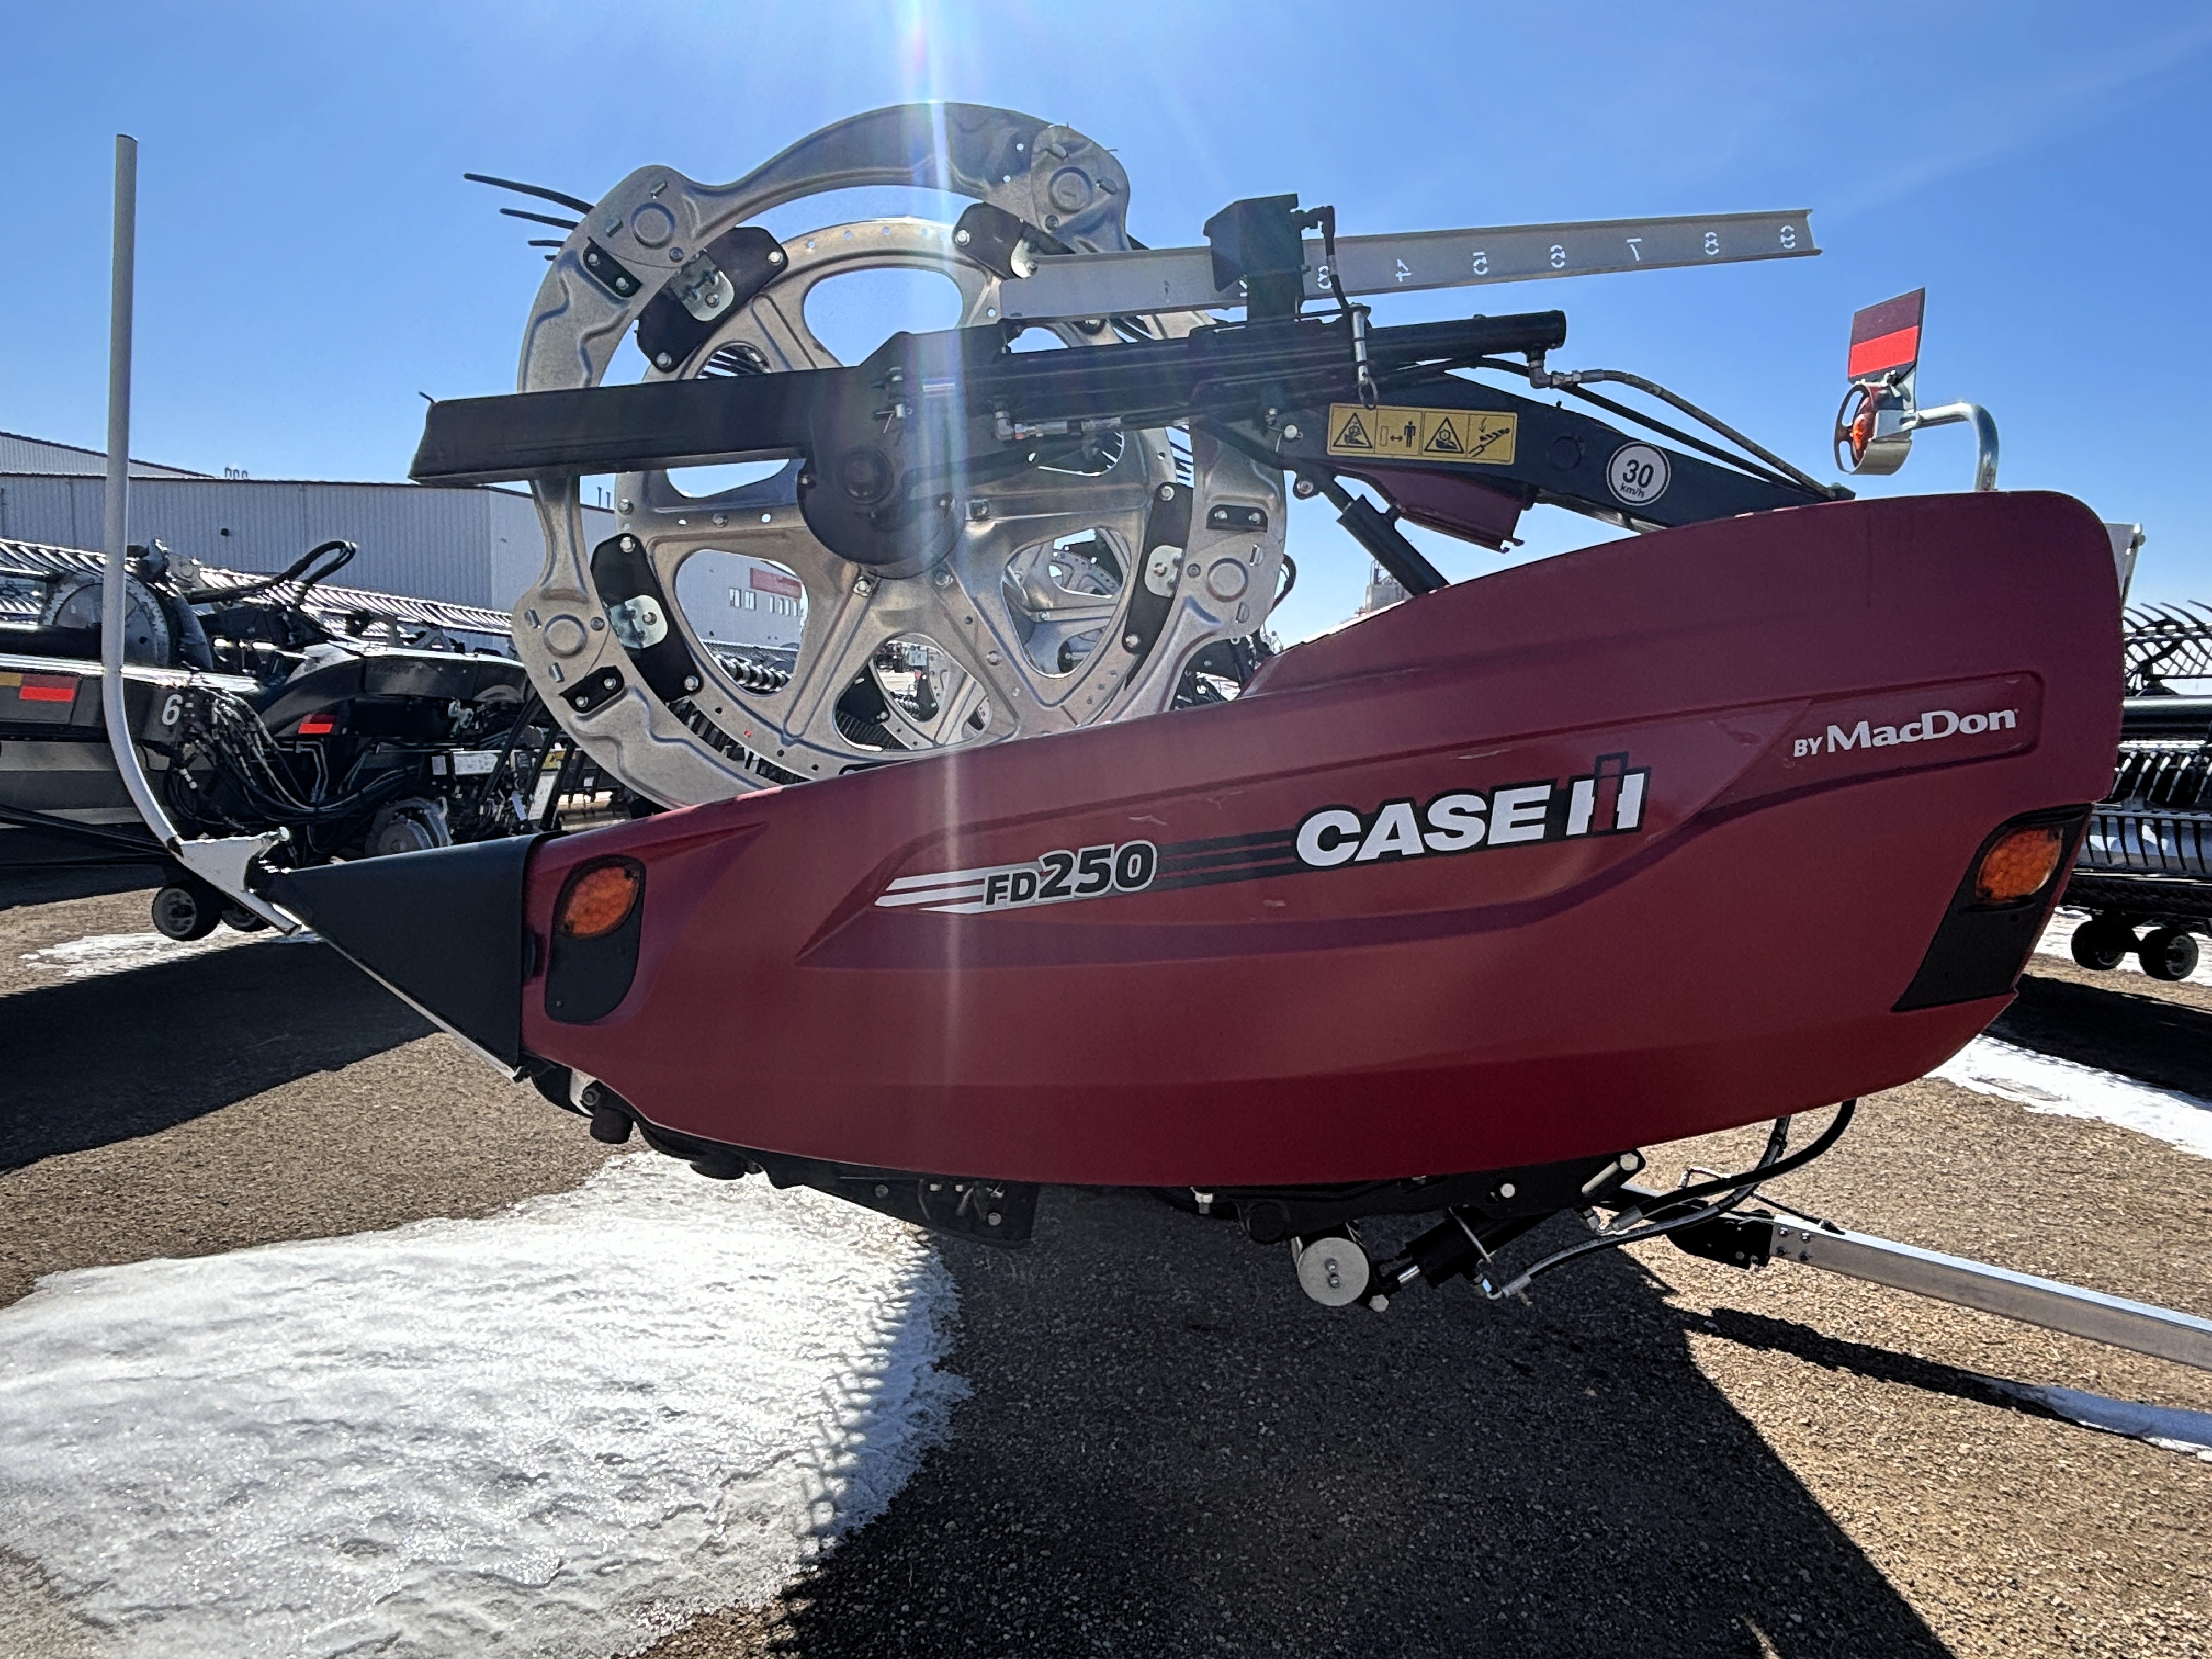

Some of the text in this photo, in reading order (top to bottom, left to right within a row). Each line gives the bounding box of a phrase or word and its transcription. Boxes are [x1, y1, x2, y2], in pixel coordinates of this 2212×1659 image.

[1623, 459, 1654, 488] 30
[1620, 482, 1645, 498] km/h
[161, 693, 183, 725] 6
[1793, 708, 2017, 757] BY MacDon
[984, 841, 1156, 906] FD250
[1295, 783, 1553, 867] CASE
